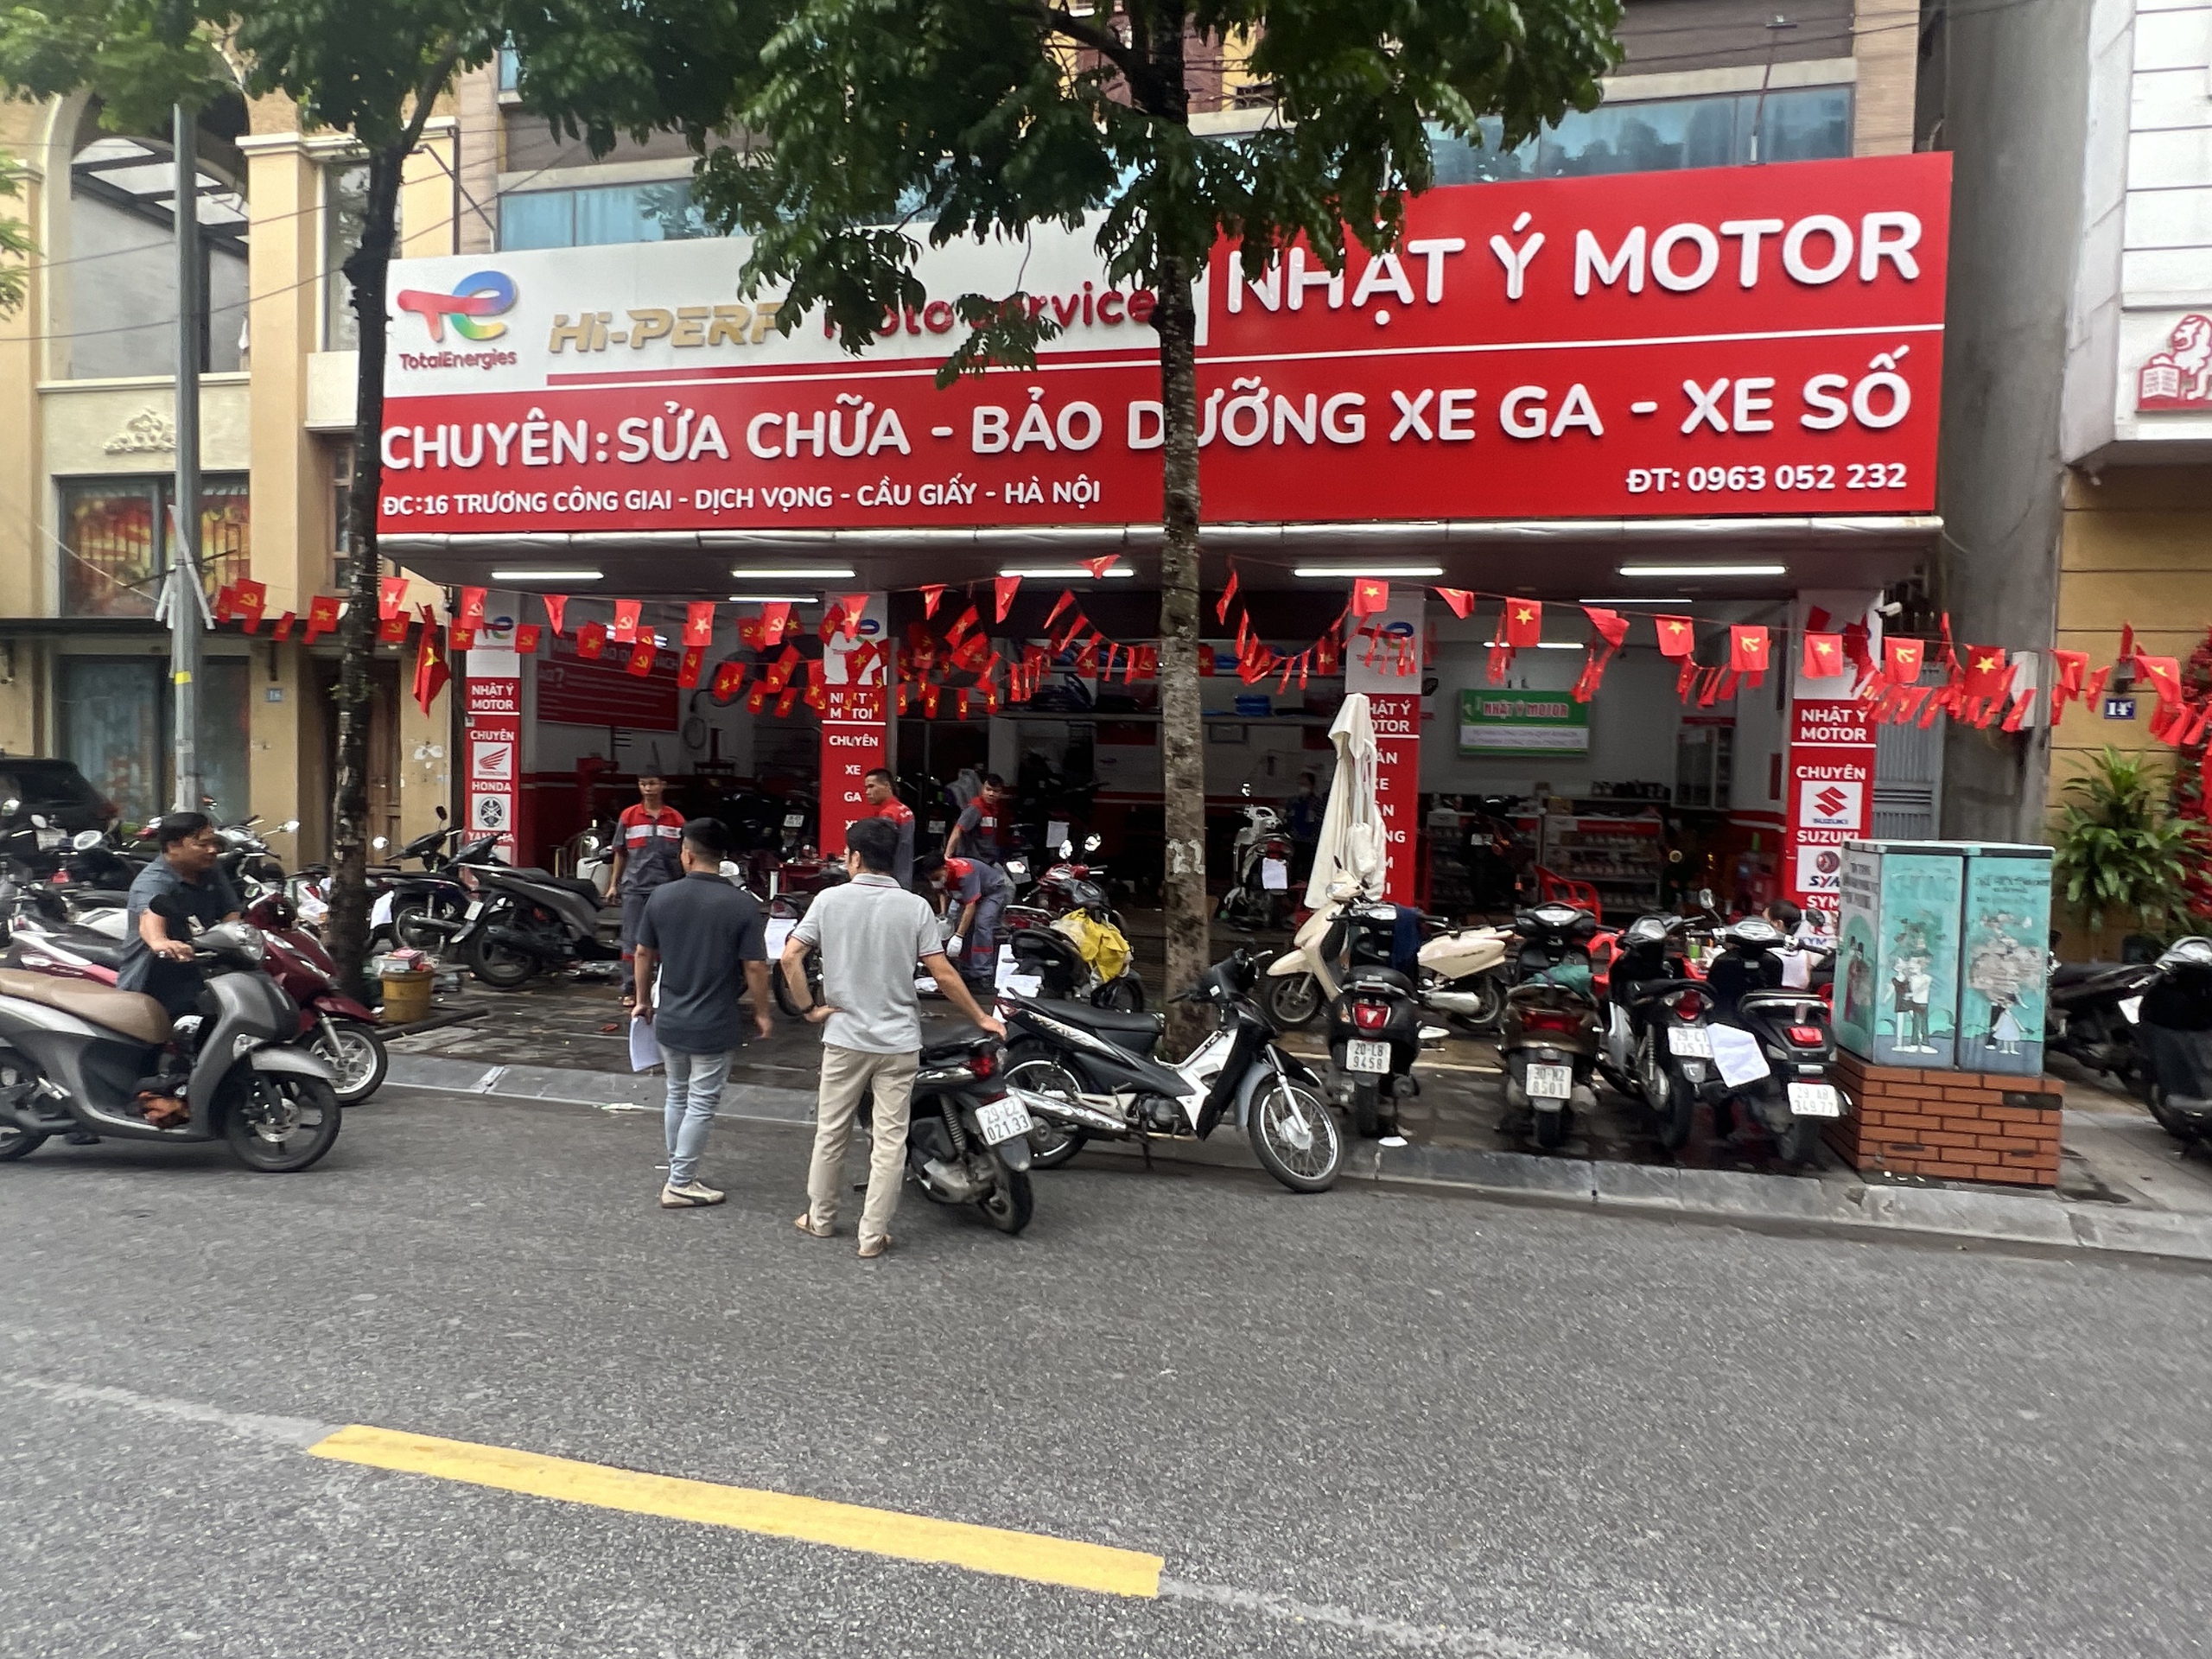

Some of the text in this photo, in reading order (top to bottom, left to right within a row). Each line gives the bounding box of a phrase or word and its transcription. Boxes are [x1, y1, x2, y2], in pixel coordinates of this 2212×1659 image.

[1489, 212, 1546, 300] Ý
[1573, 211, 1922, 296] MOTOR
[399, 348, 518, 371] TotalEnergies
[747, 393, 912, 459] CHỮA
[972, 387, 1103, 454] BẢO
[1389, 388, 1478, 442] XE
[1499, 384, 1605, 440] GA
[1681, 377, 1775, 434] XE
[1800, 345, 1911, 429] SỐ
[1626, 462, 1907, 493] ĐT: 0963 052 232
[453, 490, 547, 514] TRƯƠNG
[552, 486, 619, 512] CÔNG
[625, 489, 672, 511] GIAI
[695, 487, 754, 515] DỊCH
[761, 486, 832, 513] VỌNG
[857, 474, 912, 506] CẦU
[918, 472, 977, 506] GIẤY
[1005, 476, 1045, 504] HÀ
[1053, 474, 1101, 510] NỘI
[471, 682, 514, 698] NHẬT Ý
[472, 699, 514, 710] MOTOR
[1401, 699, 1411, 715] Ý
[1801, 705, 1868, 726] NHẬT Ý
[1371, 719, 1410, 733] OTOR
[1800, 726, 1867, 741] MOTOR
[469, 728, 515, 741] CHUYÊN
[829, 733, 879, 747] CHUYÊN
[845, 764, 861, 775] XE
[1796, 765, 1866, 780] CHUYÊN
[471, 781, 512, 792] HONDA
[843, 791, 862, 802] GA
[1796, 830, 1859, 843] SUZUKI
[1353, 1056, 1382, 1070] 9458
